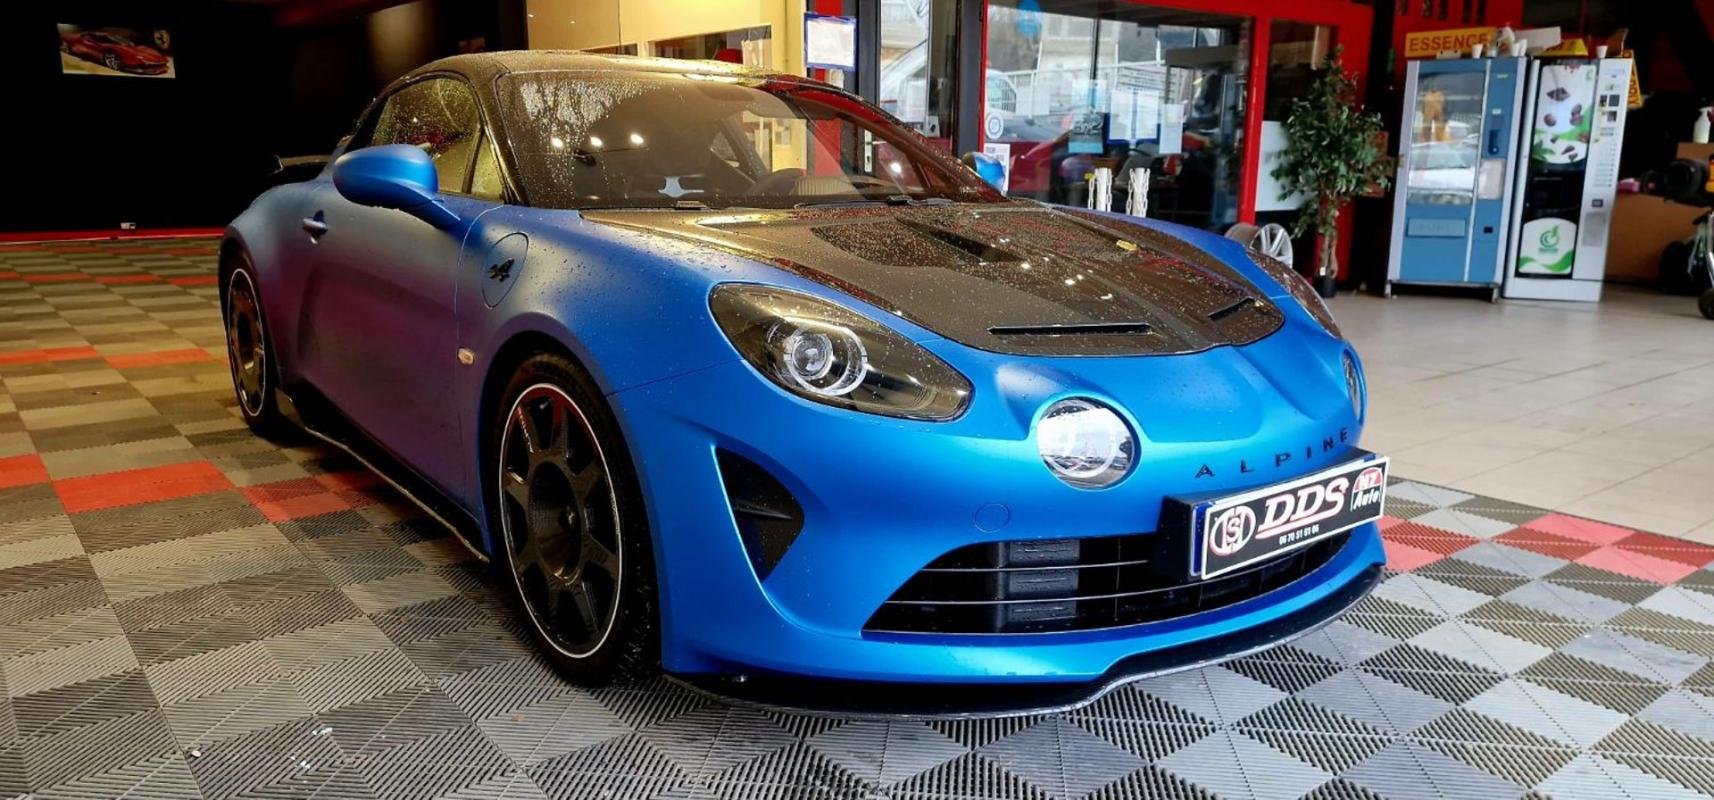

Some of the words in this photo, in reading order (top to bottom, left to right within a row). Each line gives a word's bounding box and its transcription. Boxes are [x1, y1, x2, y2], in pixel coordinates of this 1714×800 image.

[1195, 431, 1349, 478] ALPINE
[1257, 477, 1350, 534] DDS
[1353, 488, 1380, 510] Auto
